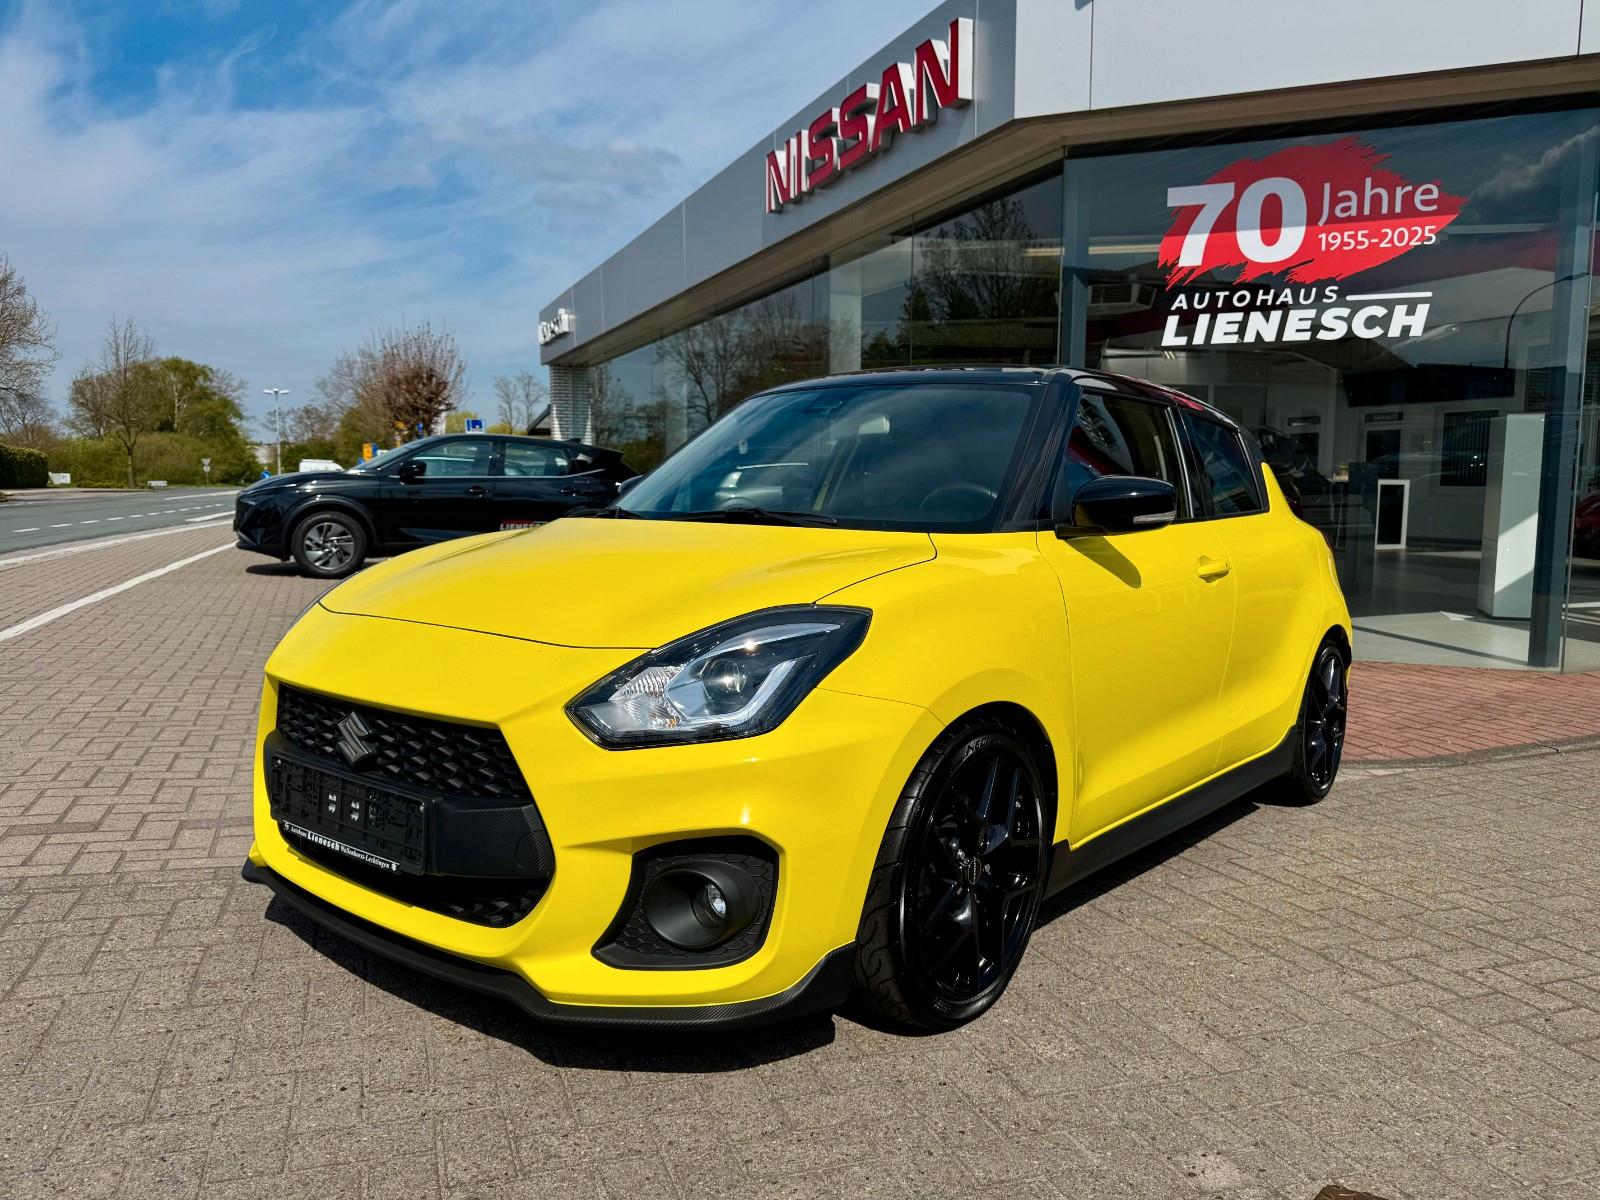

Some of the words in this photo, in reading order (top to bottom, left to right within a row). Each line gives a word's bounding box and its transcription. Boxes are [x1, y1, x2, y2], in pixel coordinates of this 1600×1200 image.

[766, 17, 973, 213] NISSAN
[1166, 177, 1307, 267] 70
[1318, 177, 1439, 226] Jahre
[1318, 225, 1437, 252] 1955-2025
[1170, 285, 1339, 311] AUTOHAUS
[1160, 303, 1431, 347] LIENESCH
